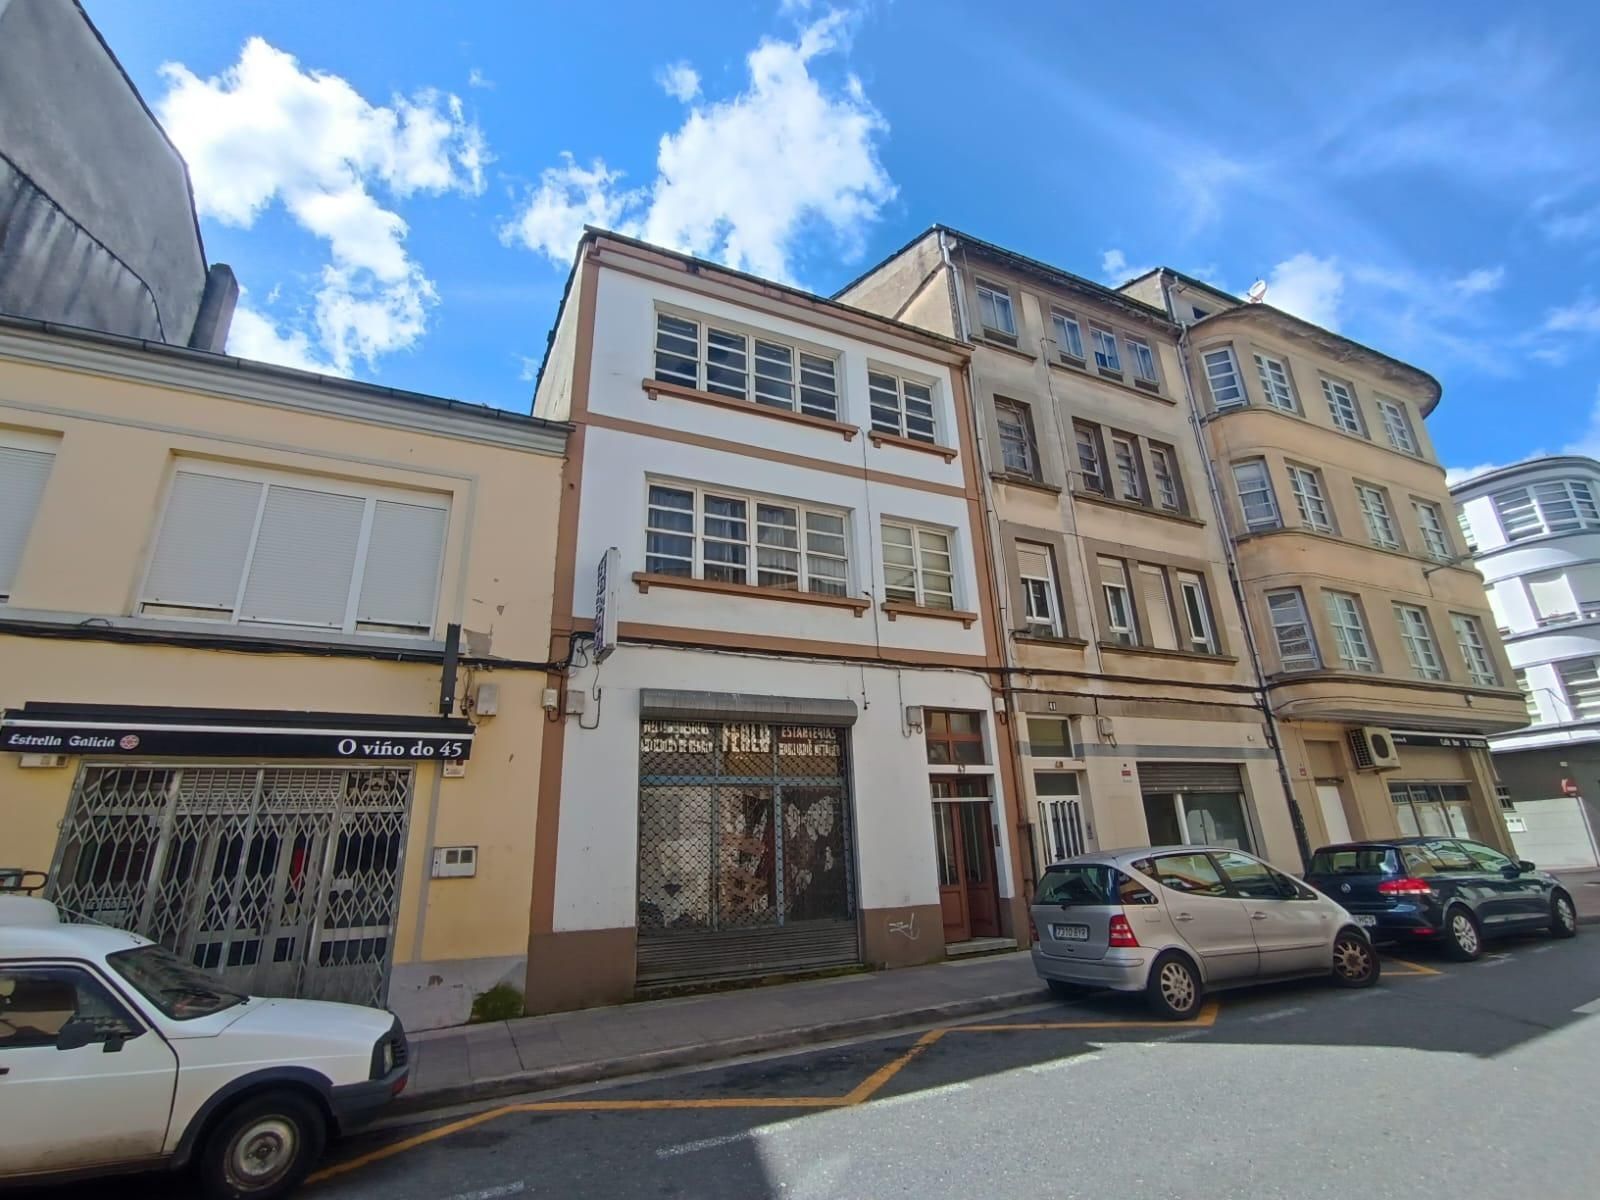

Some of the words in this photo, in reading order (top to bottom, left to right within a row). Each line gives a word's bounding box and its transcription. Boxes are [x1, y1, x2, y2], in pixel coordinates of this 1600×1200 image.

[8, 734, 62, 746] Estrella
[69, 735, 115, 748] Galicia
[338, 738, 357, 755] O
[362, 741, 405, 756] viño
[410, 740, 434, 756] do
[439, 741, 463, 757] 45
